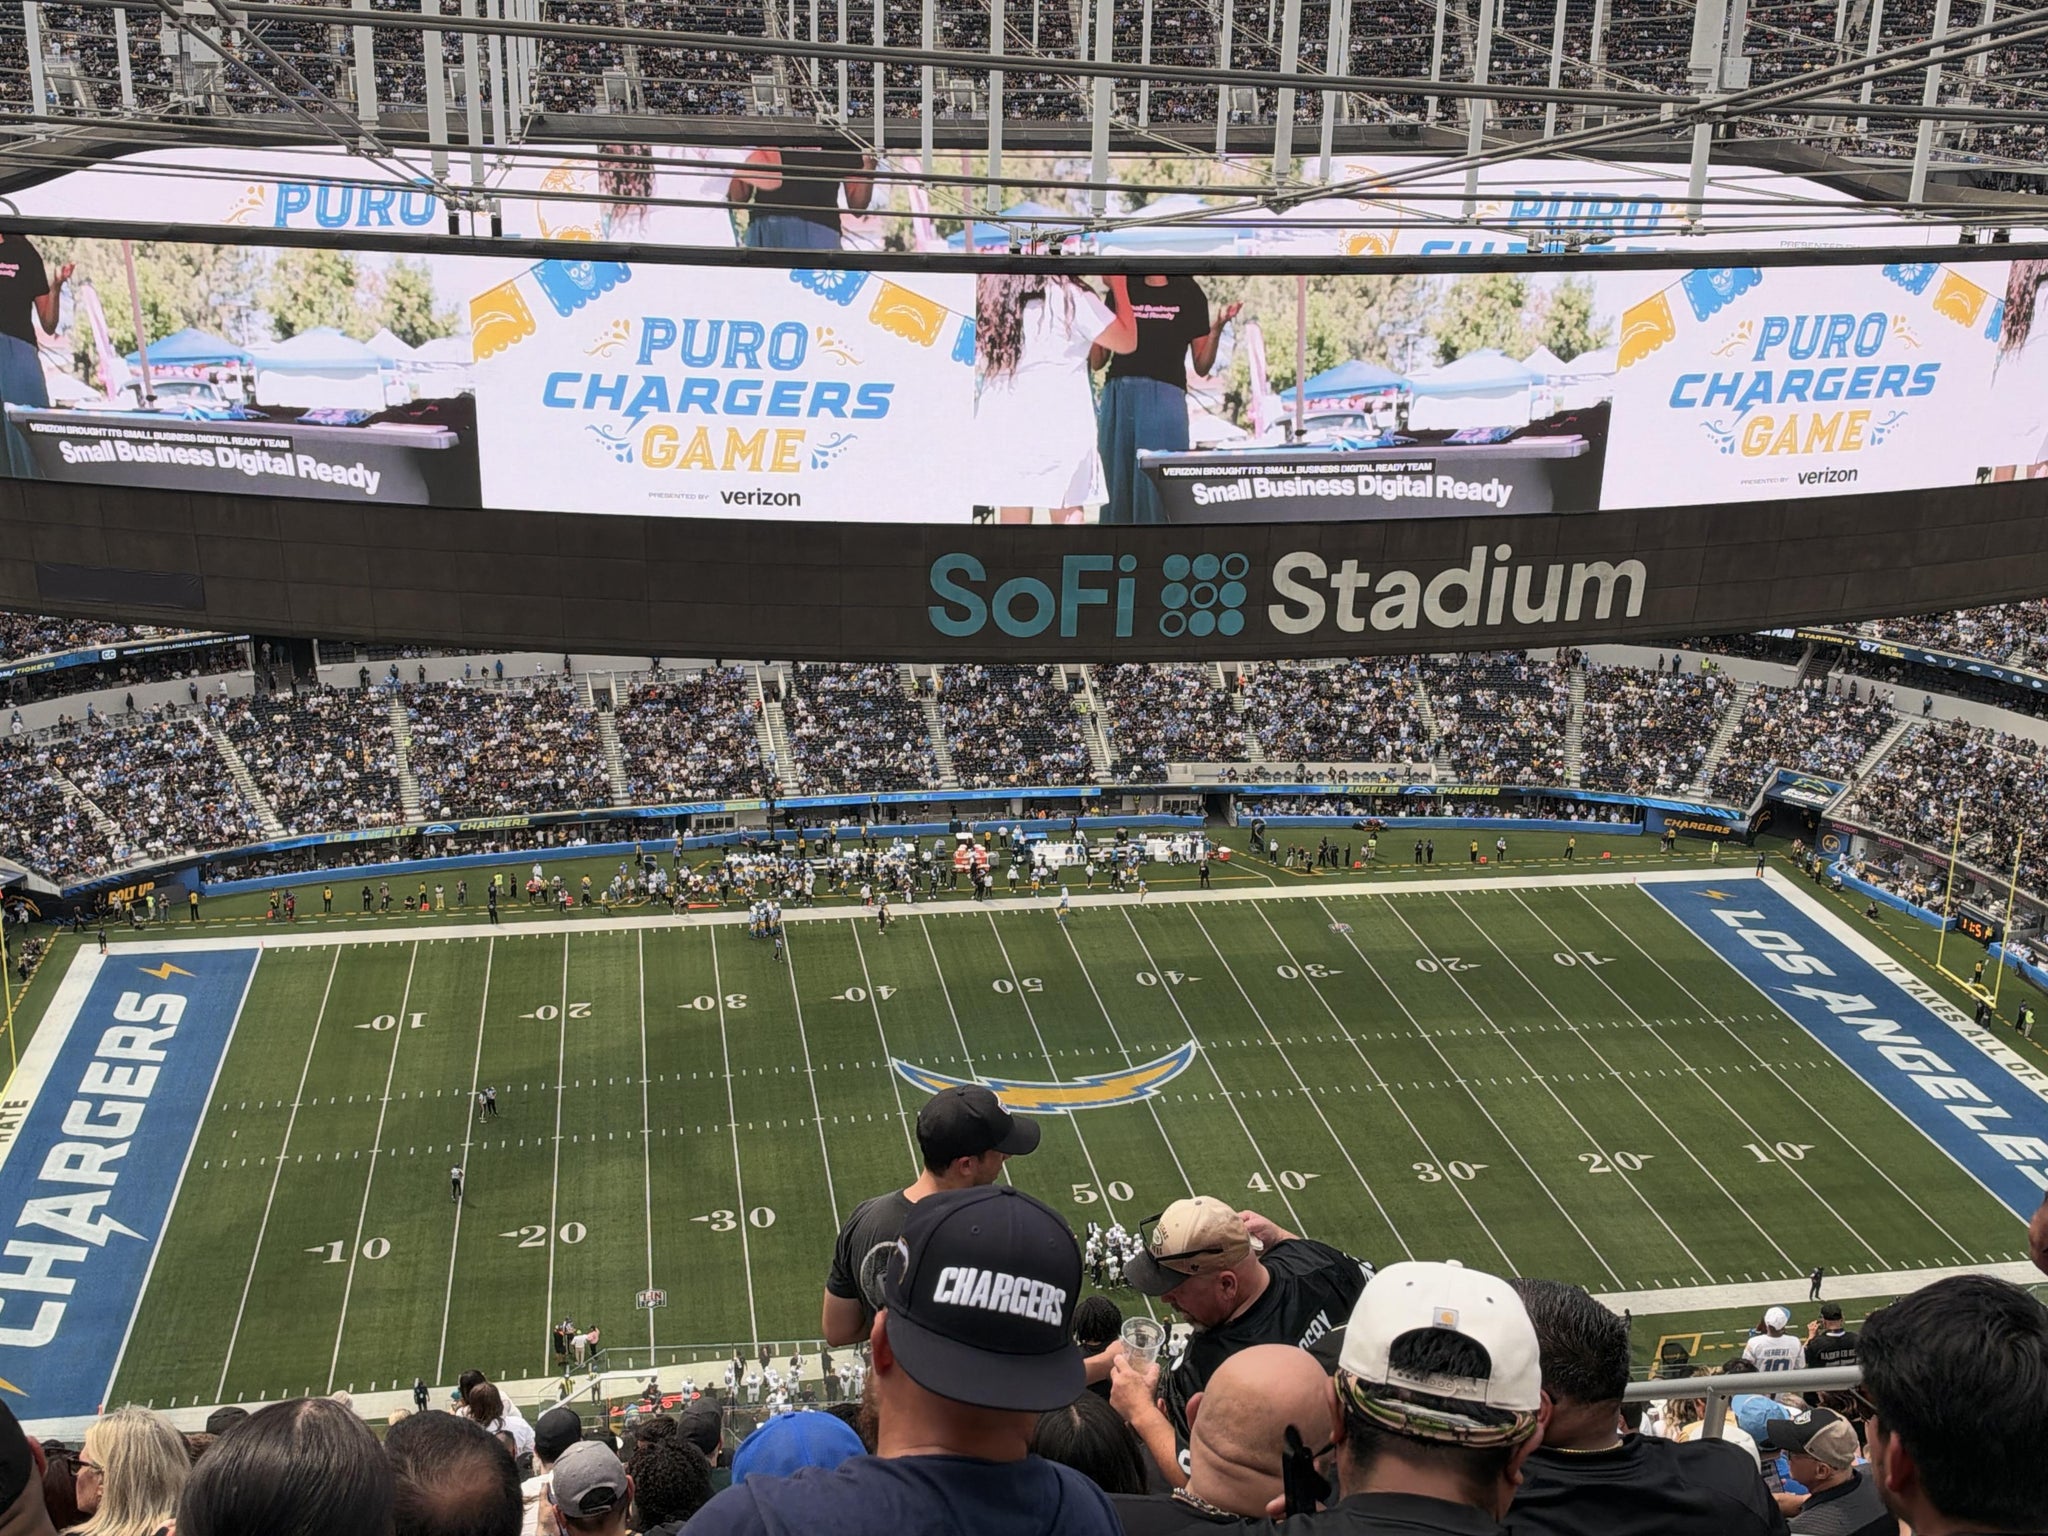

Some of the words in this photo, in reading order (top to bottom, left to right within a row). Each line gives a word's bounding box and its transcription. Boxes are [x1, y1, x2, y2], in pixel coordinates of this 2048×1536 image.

[273, 178, 437, 229] PURO
[636, 316, 809, 372] PURO
[1752, 311, 1888, 362] PURO
[542, 371, 896, 436] CHARGERS
[1669, 362, 1942, 427] CHARGERS
[29, 422, 66, 433] VERIZON
[67, 425, 107, 437] BROUGHT
[108, 428, 122, 438] ITS
[123, 430, 153, 441] SMALL
[153, 432, 196, 443] BUSINESS
[197, 435, 231, 445] DIGITAL
[231, 436, 262, 447] READY
[263, 438, 290, 449] TEAM
[1740, 409, 1872, 457] GAME
[640, 423, 807, 474] GAME
[58, 439, 118, 464] Small
[114, 439, 216, 467] Business
[215, 446, 296, 477] Digital
[296, 453, 381, 496] Ready
[1162, 467, 1202, 476] VERIZON
[1203, 466, 1248, 476] BROUGHT
[1248, 466, 1263, 475] ITS
[1264, 465, 1295, 475] SMALL
[1296, 464, 1340, 475] BUSINESS
[1341, 462, 1374, 474] DIGITAL
[1375, 462, 1406, 473] READY
[1406, 461, 1433, 471] TEAM
[1797, 466, 1859, 485] verizon
[648, 492, 696, 501] PRESENTED
[719, 487, 801, 507] verizon
[1191, 477, 1253, 506] Small
[1252, 476, 1356, 499] Business
[1357, 474, 1434, 501] Digital
[1435, 475, 1514, 509] Ready
[928, 552, 1138, 638] SoFi
[1267, 543, 1647, 635] Stadium
[1797, 632, 1843, 644] STARTING
[1345, 785, 1399, 795] ANGELES
[1435, 786, 1500, 796] CHARGERS
[355, 826, 418, 841] ANGELES
[458, 817, 530, 832] CHARGERS
[1663, 817, 1731, 836] CHARGERS
[1709, 907, 1837, 978] LOS
[1414, 956, 1469, 974] 20
[1552, 949, 1606, 968] 10
[1134, 968, 1186, 987] 40
[1275, 963, 1329, 982] 30
[844, 984, 898, 1003] 40
[991, 976, 1045, 996] 50
[534, 1001, 592, 1022] 20
[691, 993, 748, 1012] 30
[371, 1010, 428, 1031] 10
[1874, 961, 1905, 974] IT
[1899, 979, 1967, 1024] TAKES
[1960, 1028, 2007, 1058] ALL
[2005, 1061, 2044, 1082] OF
[1577, 1150, 1642, 1175] 20
[1741, 1140, 1806, 1164] 10
[0, 990, 188, 1349] CHARGERS
[1246, 1168, 1306, 1195] 40
[1411, 1159, 1476, 1183] 30
[1070, 1179, 1135, 1205] 50
[709, 1206, 777, 1232] 30
[518, 1221, 588, 1249] 20
[321, 1236, 392, 1265] 10
[932, 1266, 1067, 1327] CHARGERS
[1763, 1358, 1790, 1372] 10
